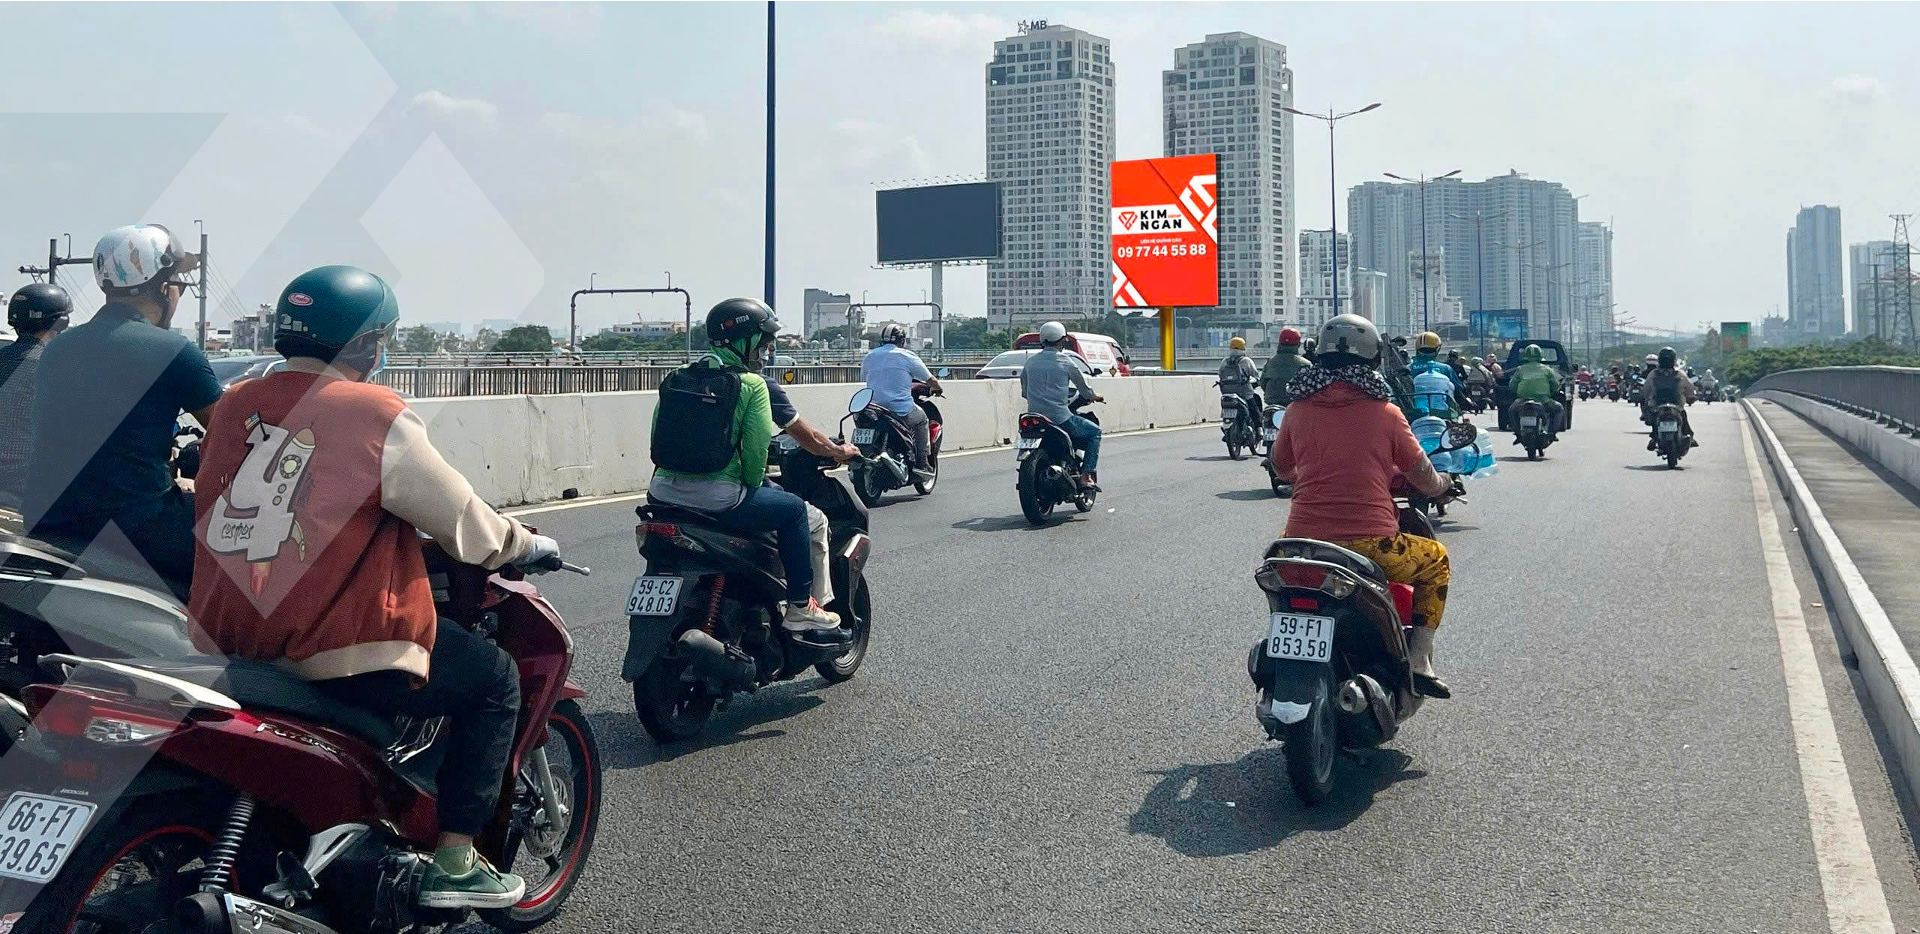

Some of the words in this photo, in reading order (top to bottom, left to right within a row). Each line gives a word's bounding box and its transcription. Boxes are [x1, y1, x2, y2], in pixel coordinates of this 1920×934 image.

[1031, 20, 1047, 30] MB
[1140, 209, 1167, 220] KIM
[1140, 219, 1182, 230] NGAN
[1118, 247, 1133, 258] 09
[1135, 246, 1151, 257] 77
[1152, 245, 1168, 256] 44
[1171, 245, 1187, 256] 55
[1189, 244, 1207, 255] 88
[638, 580, 675, 595] 59-C2
[628, 596, 673, 613] 948.03
[1279, 616, 1322, 637] 59-F1
[1271, 636, 1327, 658] 853.58
[7, 800, 78, 838] 66-F1
[0, 834, 67, 875] 39.65
